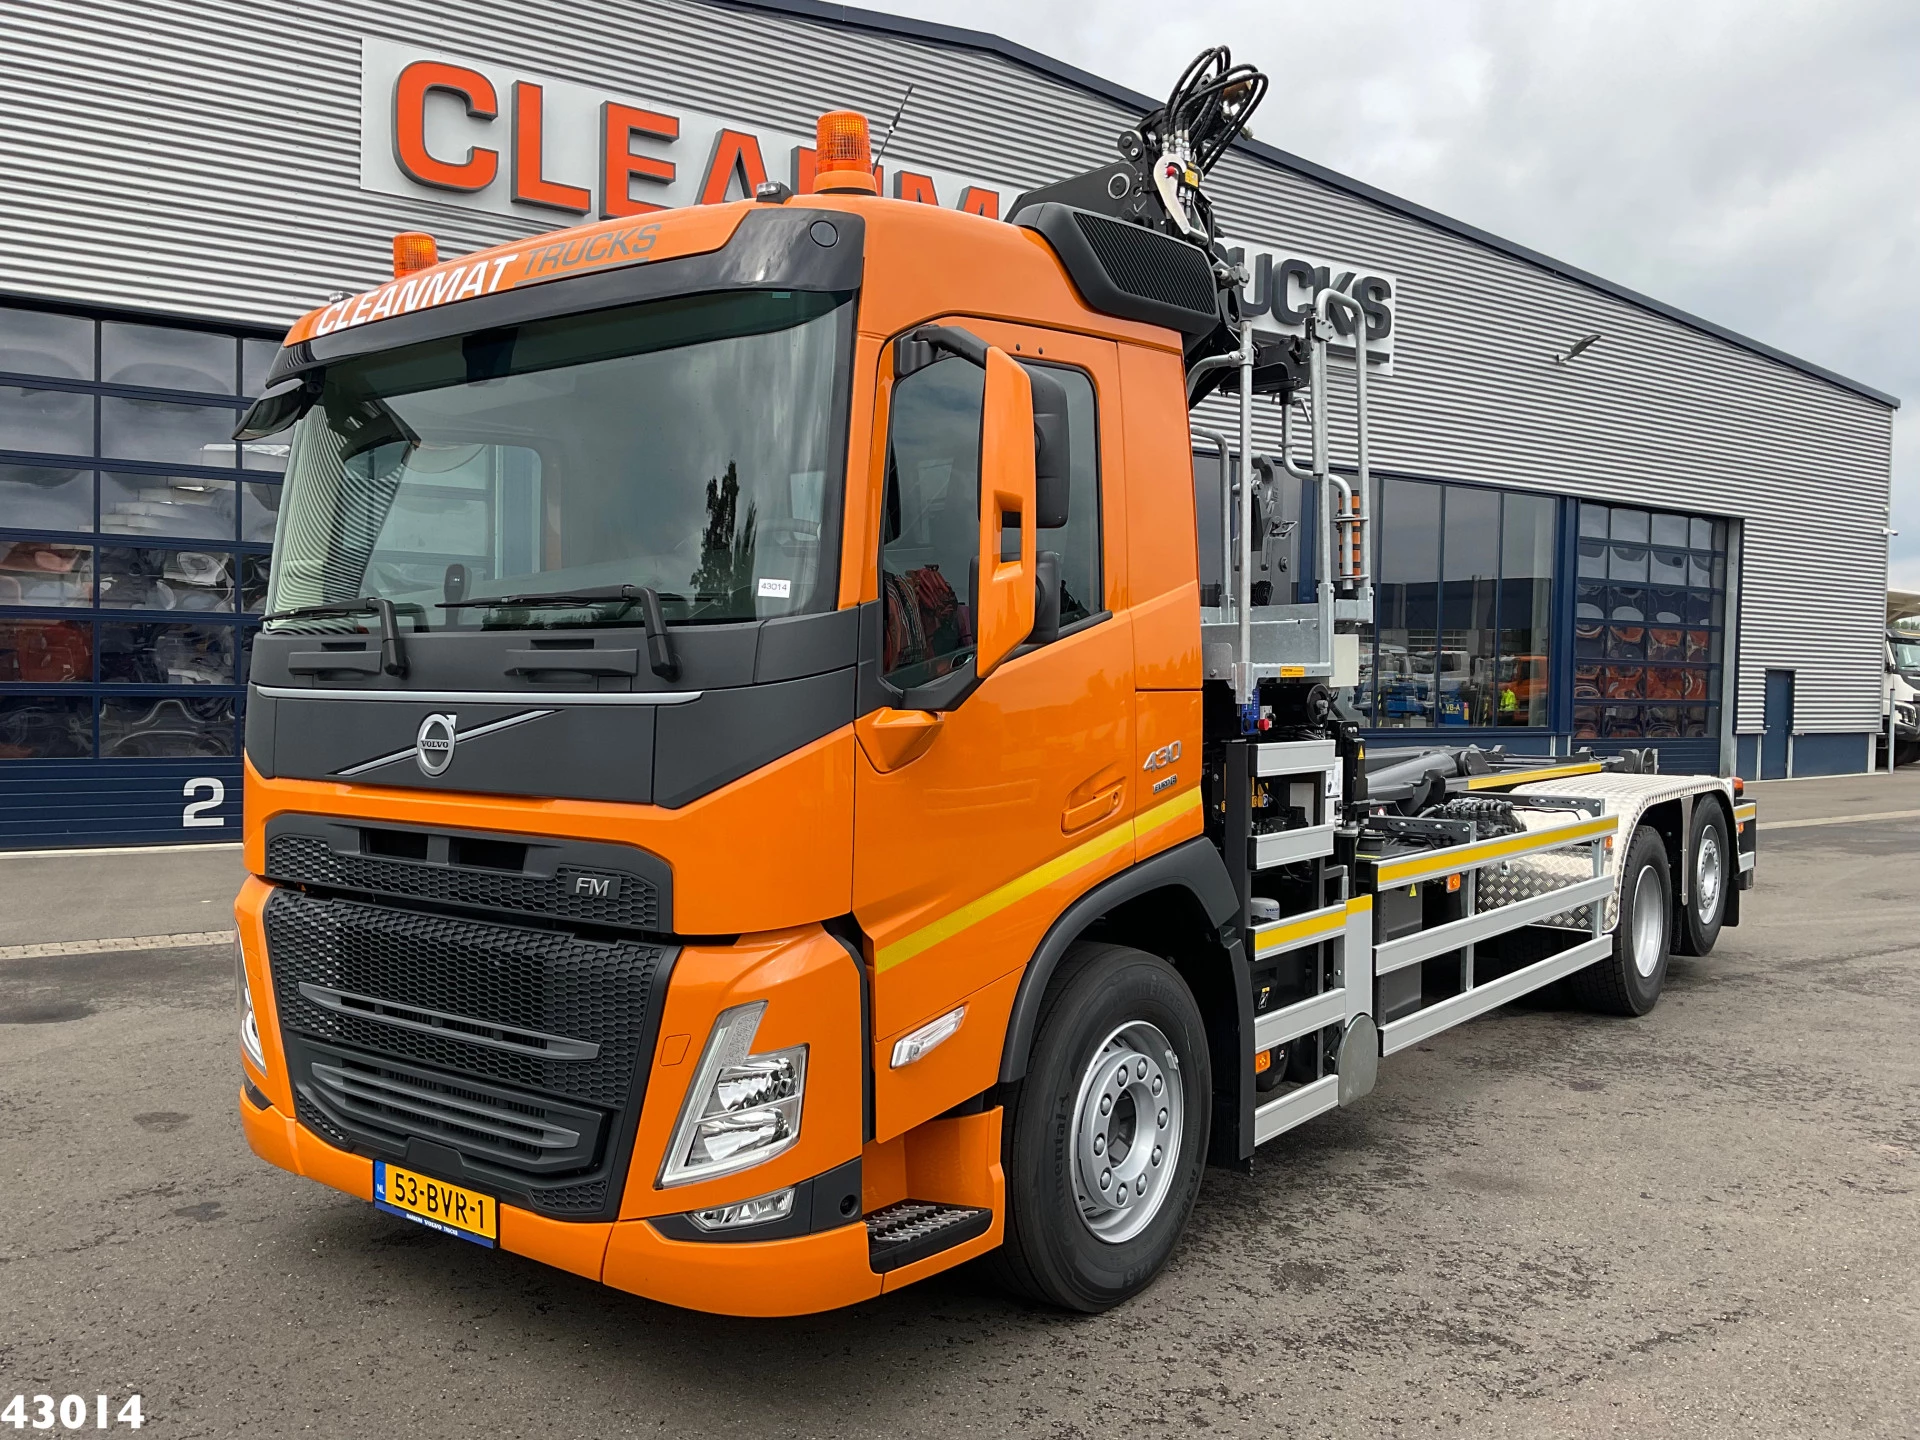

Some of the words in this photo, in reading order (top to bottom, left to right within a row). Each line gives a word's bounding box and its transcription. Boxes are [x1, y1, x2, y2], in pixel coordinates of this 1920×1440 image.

[315, 253, 519, 337] CLEANMAT
[523, 223, 661, 276] TRUCKS
[1214, 242, 1392, 341] UCKS
[761, 582, 788, 592] 43014
[421, 740, 449, 748] VOLVO
[1143, 740, 1182, 772] 430
[183, 777, 224, 827] 2
[575, 877, 611, 897] FM
[376, 1183, 385, 1195] NL
[395, 1172, 484, 1229] 53-BVR-1
